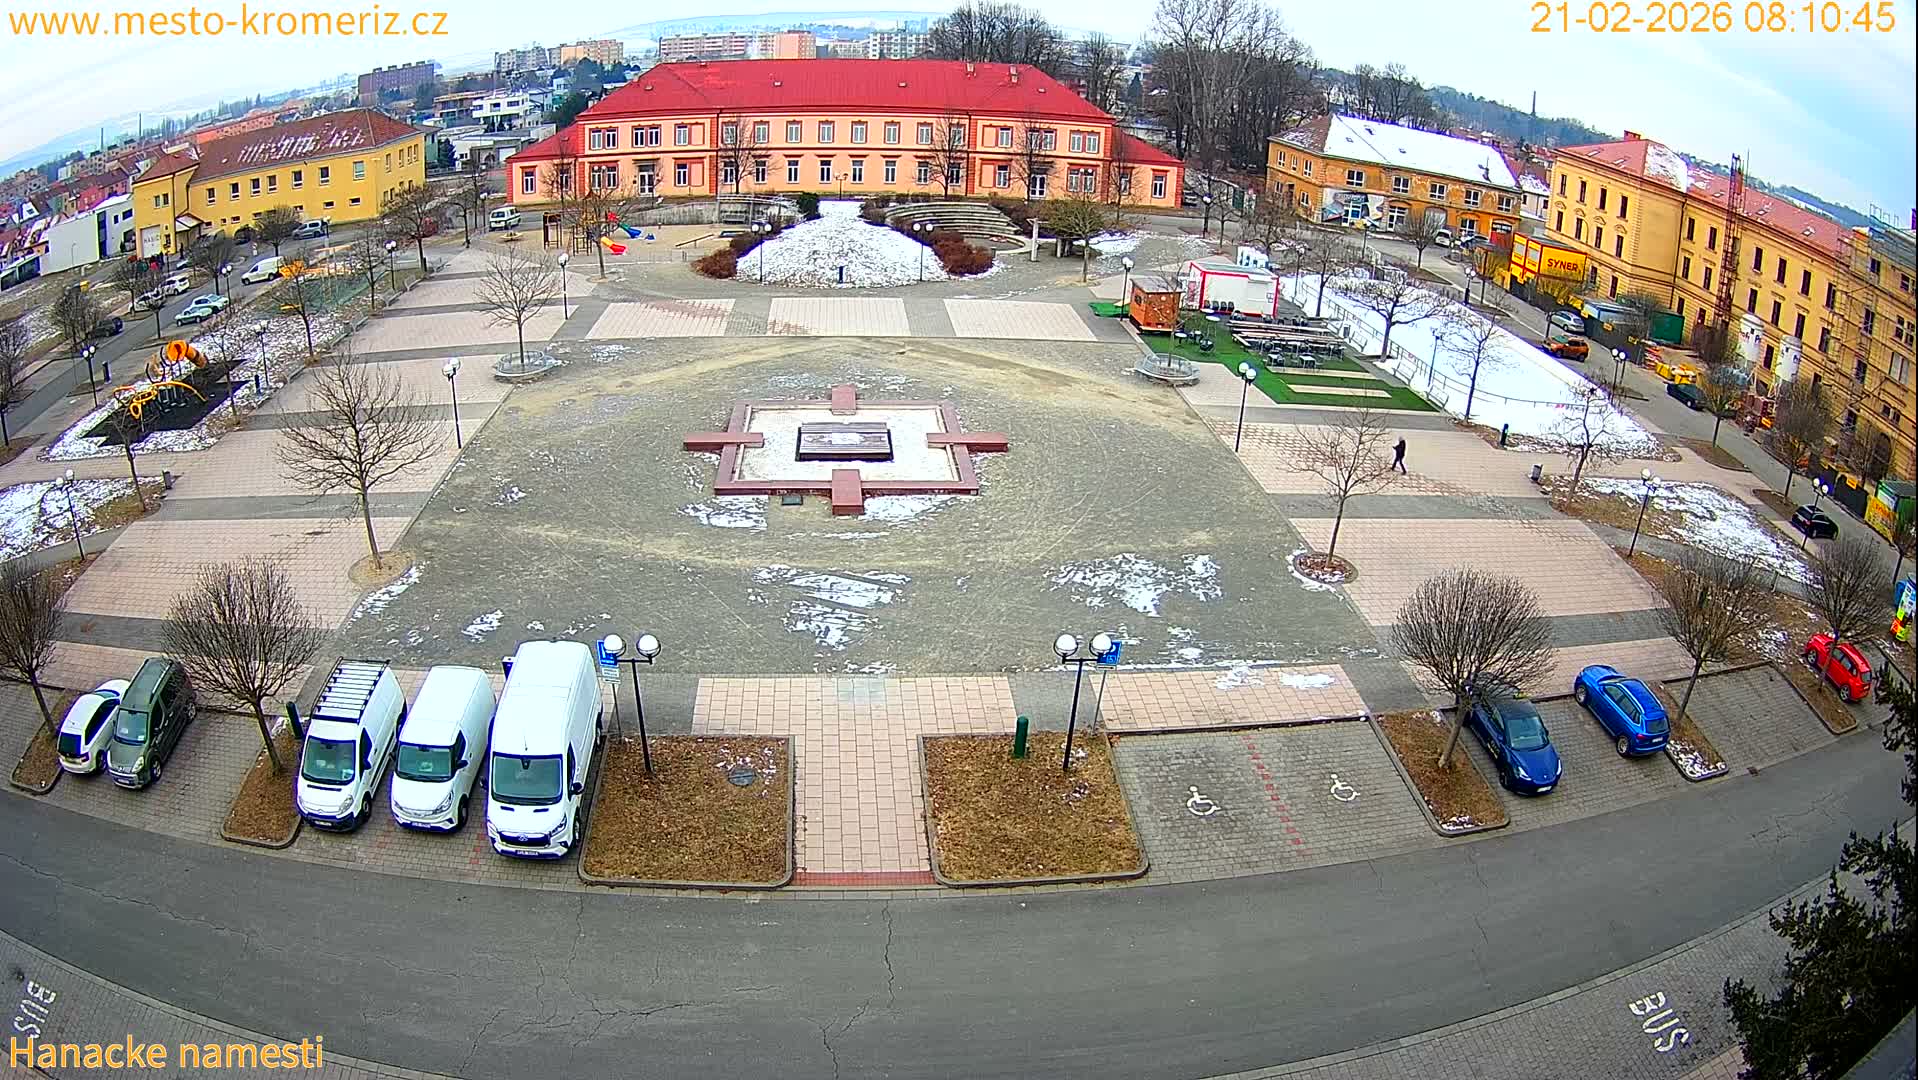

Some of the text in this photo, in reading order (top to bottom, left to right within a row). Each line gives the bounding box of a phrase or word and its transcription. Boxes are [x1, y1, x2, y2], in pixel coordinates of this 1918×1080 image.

[1547, 258, 1579, 272] SYNER
[13, 981, 57, 1039] BUS
[1628, 991, 1690, 1052] BUS
